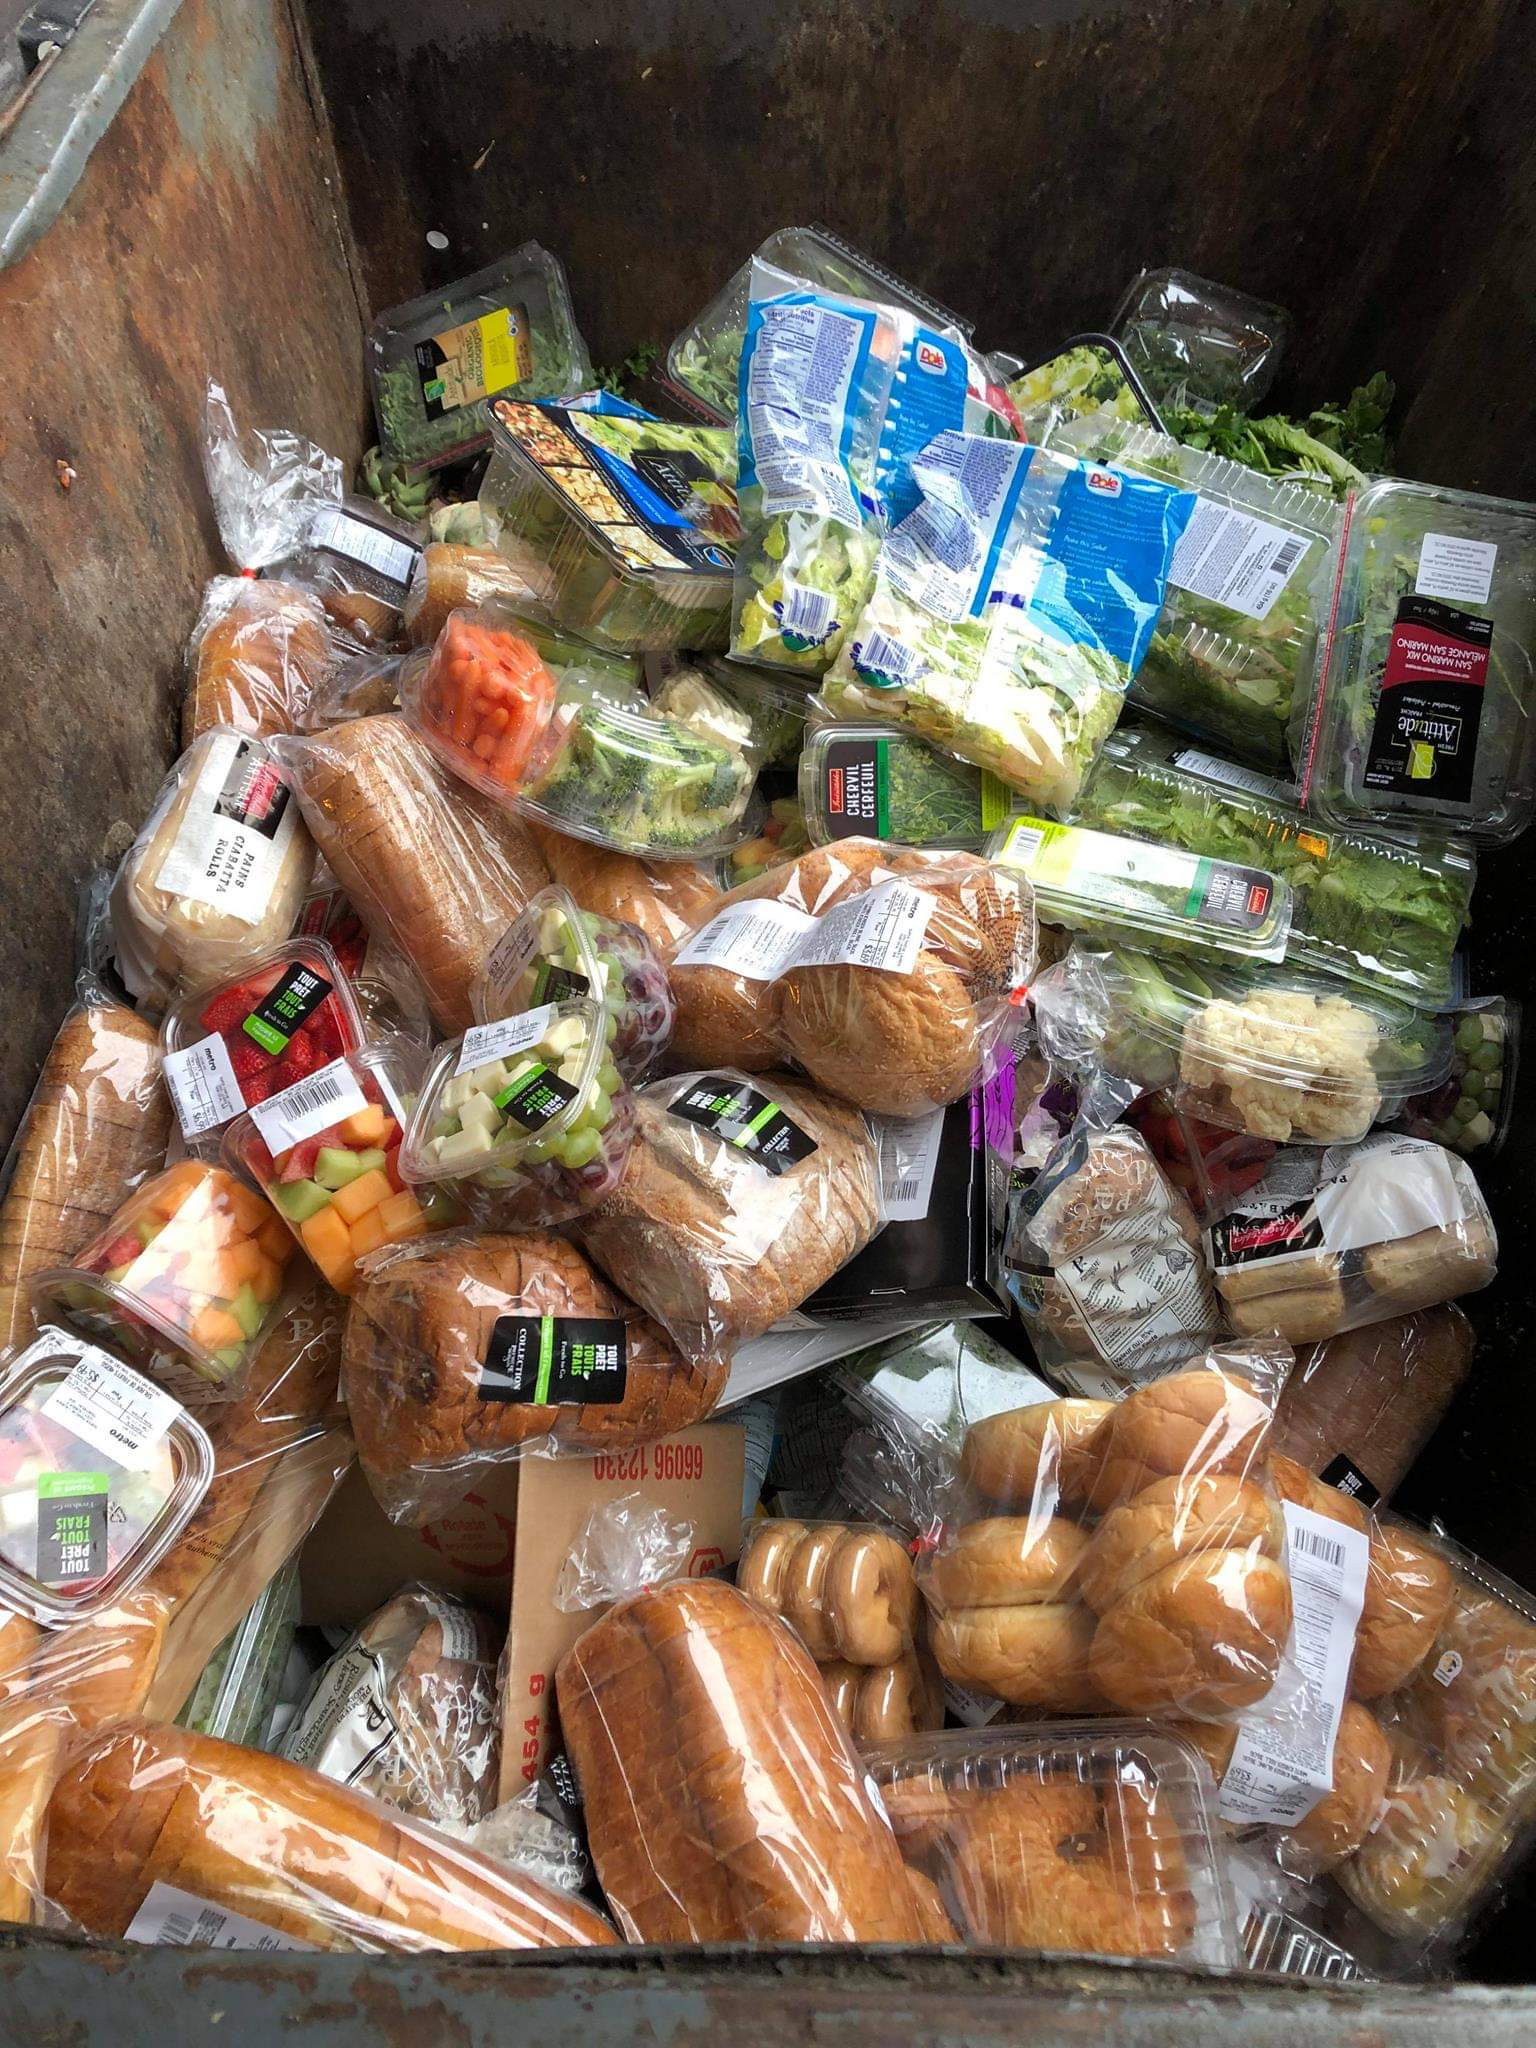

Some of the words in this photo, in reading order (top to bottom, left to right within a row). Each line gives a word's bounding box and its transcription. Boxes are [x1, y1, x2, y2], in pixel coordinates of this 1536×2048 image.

[472, 327, 483, 386] BIOLOGIQUE
[920, 347, 943, 366] Dole
[1090, 472, 1119, 487] Dole
[647, 455, 716, 527] Attitde
[1396, 637, 1428, 652] MARINO
[1406, 650, 1421, 660] MIX
[1428, 643, 1447, 655] SAN
[1447, 647, 1486, 663] MÉLANGE
[1422, 652, 1454, 666] MARINO
[1454, 659, 1473, 670] SAN
[1396, 716, 1456, 743] Attitude
[846, 764, 860, 816] CHERVIL
[861, 761, 874, 818] CERFEUIL
[206, 838, 227, 879] ROLLS
[215, 835, 246, 893] CIABATTA
[235, 853, 255, 888] PAINS
[1206, 874, 1230, 909] CERFEUIL
[1225, 879, 1248, 912] CHERVIL
[907, 897, 920, 918] metro
[296, 971, 319, 989] TOUT
[273, 999, 299, 1019] FRAIS
[282, 990, 303, 1007] TOUT
[204, 1047, 217, 1071] metro
[522, 1085, 549, 1109] FRAIS
[532, 1090, 555, 1110] TOUT
[544, 1099, 567, 1118] TOUT
[761, 1125, 791, 1154] COLLECTION
[513, 1328, 527, 1390] COLLECTION
[560, 1341, 568, 1360] Fresh
[570, 1344, 583, 1376] FRAIS
[583, 1344, 595, 1371] TOUT
[606, 1344, 618, 1371] TOUT
[1113, 1345, 1133, 1364] Valeur
[559, 1369, 566, 1379] Go
[109, 1428, 139, 1452] metro
[654, 1446, 702, 1480] 66096
[1344, 1471, 1362, 1490] TOUT
[56, 1516, 90, 1530] FRAIS
[442, 1519, 487, 1531] Rotate
[61, 1530, 90, 1544] TOUT
[60, 1543, 90, 1559] PRÊT
[60, 1559, 90, 1574] TOUT
[333, 1659, 353, 1695] Honey
[529, 1673, 545, 1696] g
[295, 1695, 337, 1755] Sourdough
[521, 1715, 540, 1781] 454
